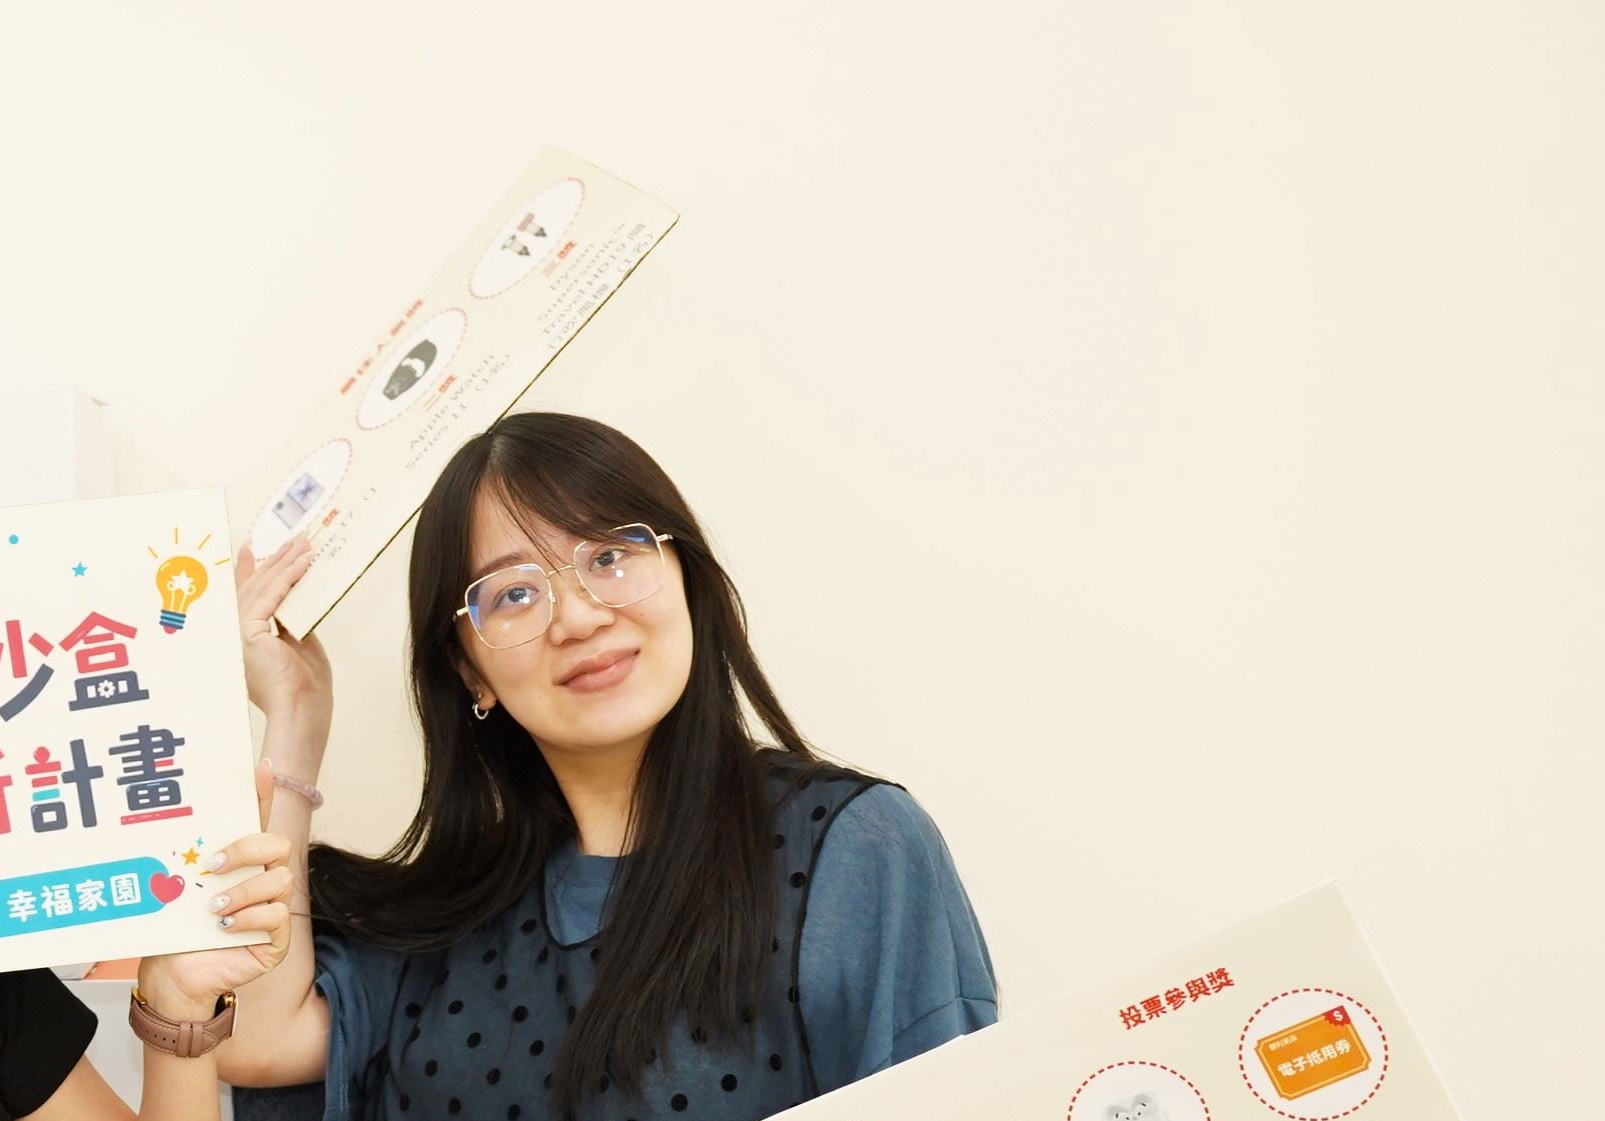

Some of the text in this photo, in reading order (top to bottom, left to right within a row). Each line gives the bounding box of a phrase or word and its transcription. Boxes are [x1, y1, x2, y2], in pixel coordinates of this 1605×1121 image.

[548, 241, 595, 291] Dyson
[540, 288, 586, 337] Travel
[407, 352, 495, 451] Apple Watch
[404, 421, 449, 473] Series
[1119, 967, 1235, 1030] 投票參與獎
[1277, 1038, 1352, 1078] 電子抵用券
